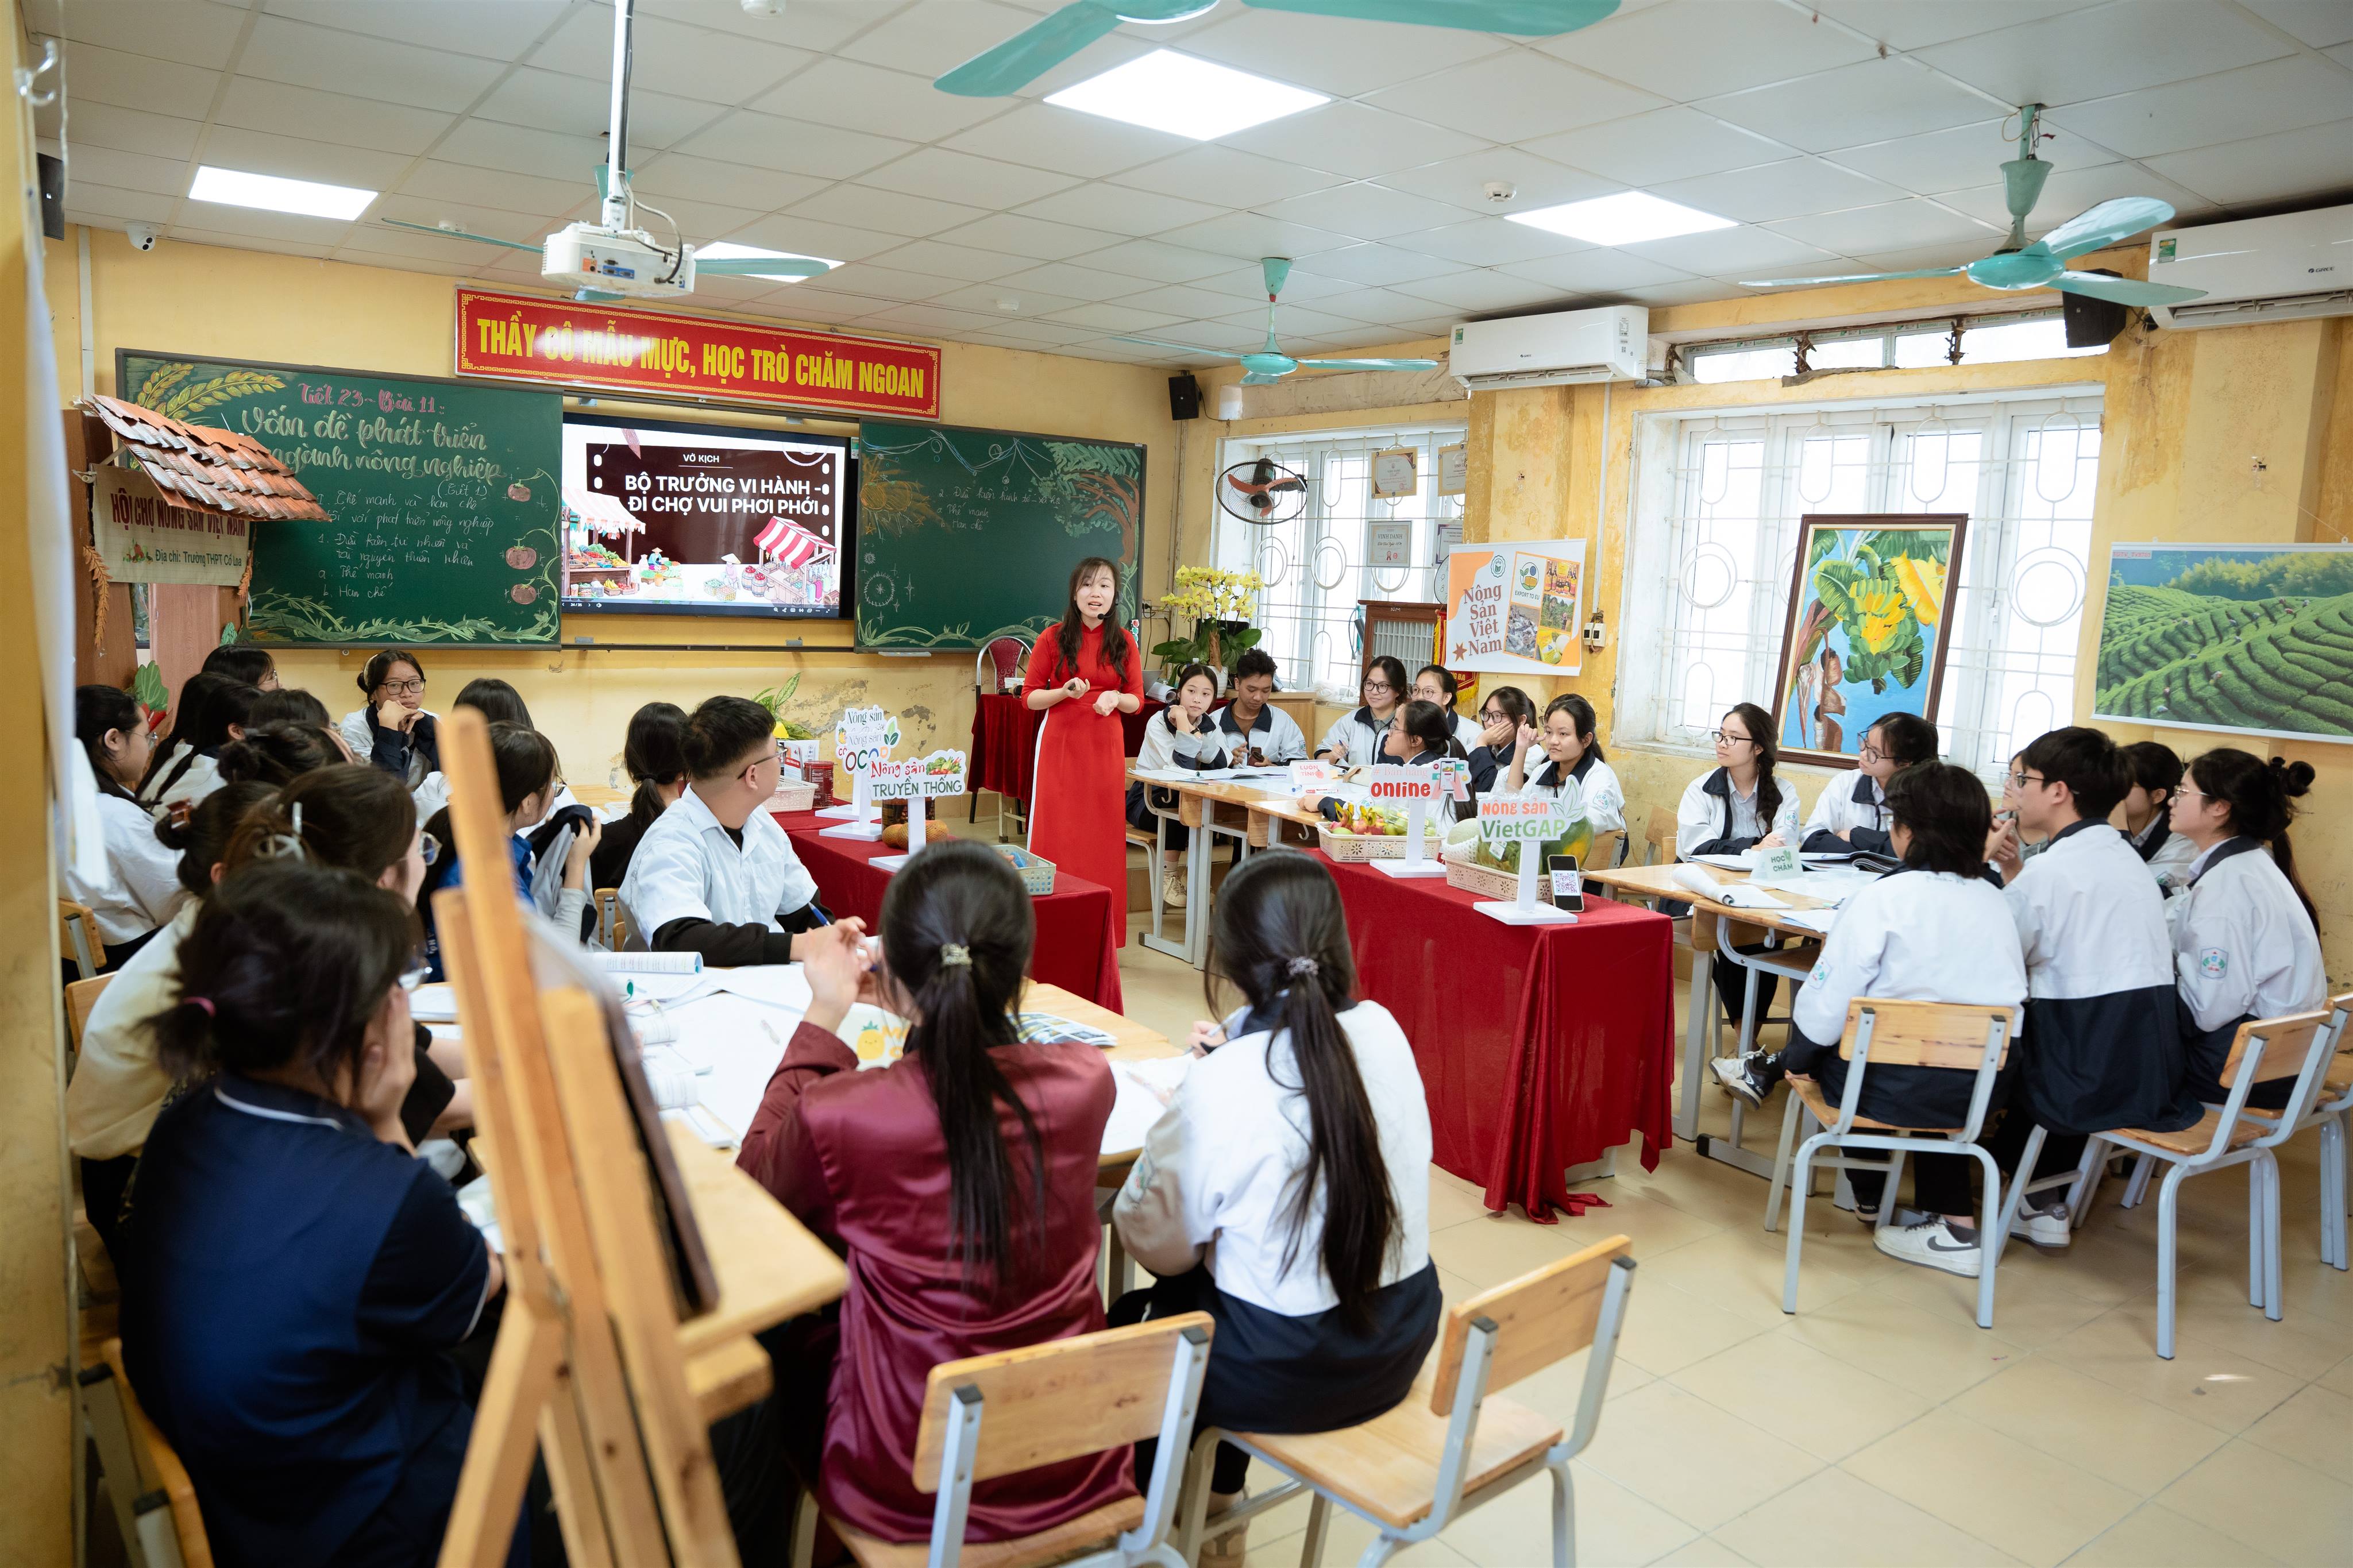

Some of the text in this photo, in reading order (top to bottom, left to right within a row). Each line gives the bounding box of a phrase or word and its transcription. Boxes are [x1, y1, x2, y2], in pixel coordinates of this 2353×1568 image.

[477, 311, 924, 398] THẦY CÔ MẪU MỰC, HỌC TRÒ CHĂM NGOAN
[337, 389, 364, 407] 23
[379, 388, 415, 413] Bài
[242, 405, 486, 450] Vấn đề phát triển
[268, 443, 507, 486] ngành nông nghiệp
[682, 453, 719, 464] VỞ KỊCH
[624, 472, 651, 495] BỘ
[655, 472, 736, 493] TRƯỞNG
[739, 478, 757, 493] VI
[760, 476, 810, 495] HÀNH
[110, 487, 133, 530] HỘI
[134, 496, 155, 533] CHỢ
[404, 495, 422, 507] và
[628, 495, 819, 516] ĐI CHỢ VUI PHƠI PHỚI
[351, 509, 371, 523] với
[433, 515, 454, 534] nông
[459, 515, 494, 536] nghiệp
[456, 538, 474, 550] và
[155, 549, 168, 564] Địa
[169, 550, 182, 562] chỉ:
[183, 551, 206, 567] Trường
[206, 553, 222, 565] THPT
[233, 557, 242, 566] Loa
[444, 550, 474, 566] nhiên
[340, 563, 363, 578] Thế
[1464, 584, 1502, 604] Nông
[1469, 600, 1497, 620] Sản
[1469, 618, 1499, 639] Việt
[1468, 639, 1502, 656] Nam
[847, 708, 882, 725] Nông sản
[871, 761, 925, 778] Nông sản
[873, 775, 962, 797] TRUYỀN THỐNG
[1482, 797, 1548, 816] Nông sản
[1482, 819, 1565, 838] VietGAP
[1771, 855, 1785, 863] HỌC
[1773, 863, 1793, 872] CHĂM
